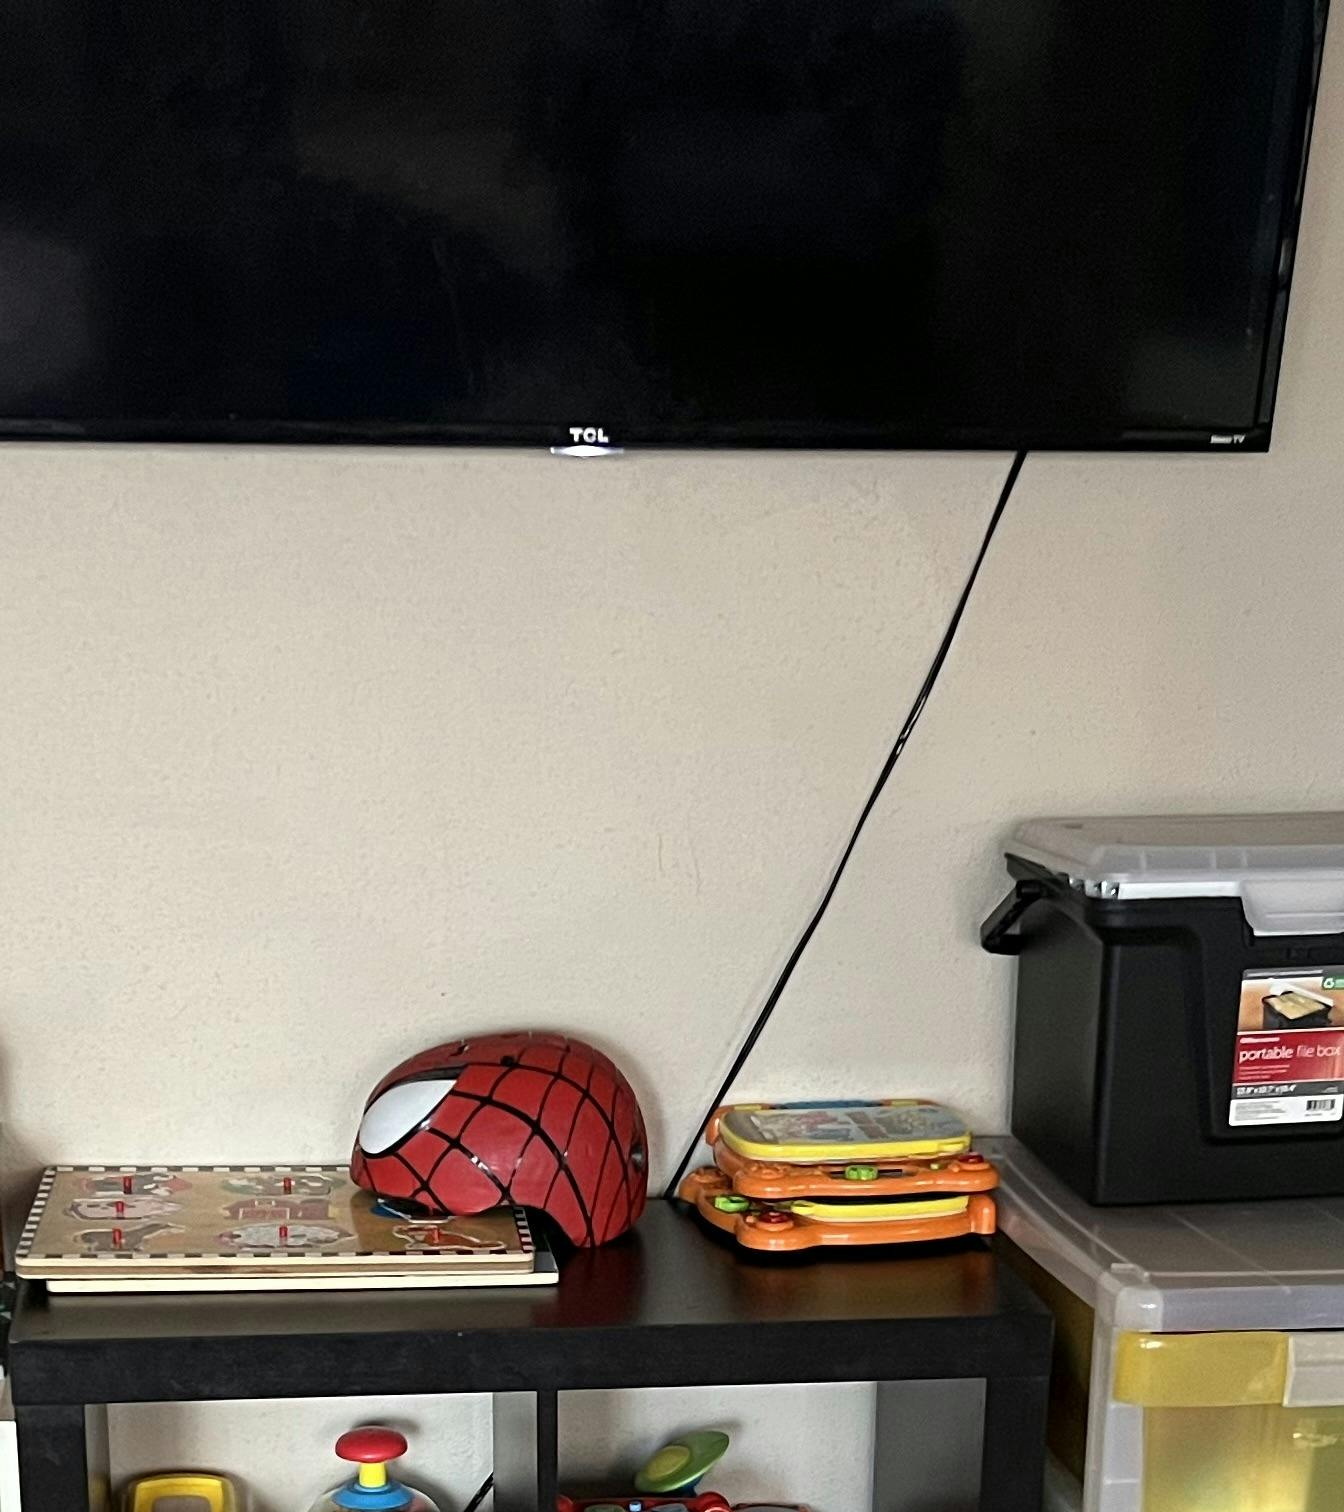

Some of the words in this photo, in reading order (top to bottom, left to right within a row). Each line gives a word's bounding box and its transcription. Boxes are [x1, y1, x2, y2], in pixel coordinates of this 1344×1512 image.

[569, 427, 609, 443] TCL
[1239, 1046, 1293, 1064] portable
[1316, 1044, 1341, 1057] box
